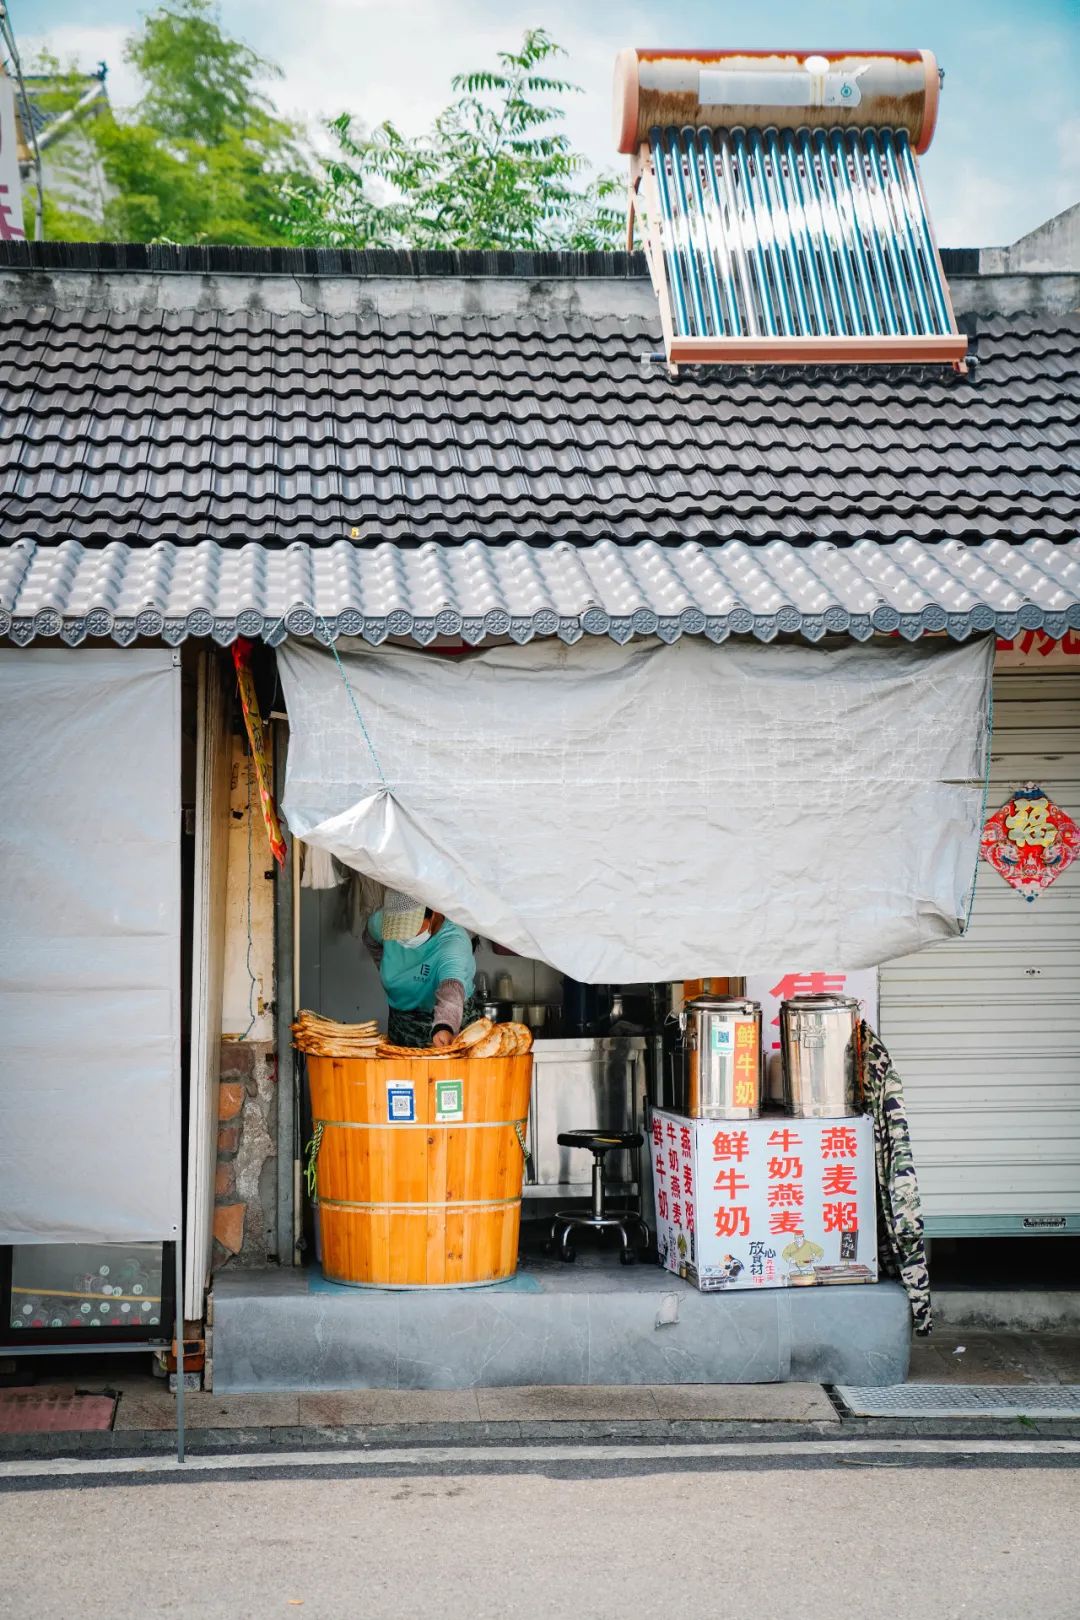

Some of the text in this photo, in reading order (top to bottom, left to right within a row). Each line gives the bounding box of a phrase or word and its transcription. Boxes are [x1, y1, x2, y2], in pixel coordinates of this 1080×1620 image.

[736, 1024, 756, 1105] 鲜牛奶
[652, 1117, 668, 1220] 鲜牛奶
[667, 1122, 681, 1225] 牛奶燕麦
[680, 1126, 695, 1233] 燕麦粥
[712, 1131, 751, 1237] 鲜牛奶
[767, 1129, 804, 1235] 牛奶燕麦
[820, 1126, 859, 1233] 燕麦粥
